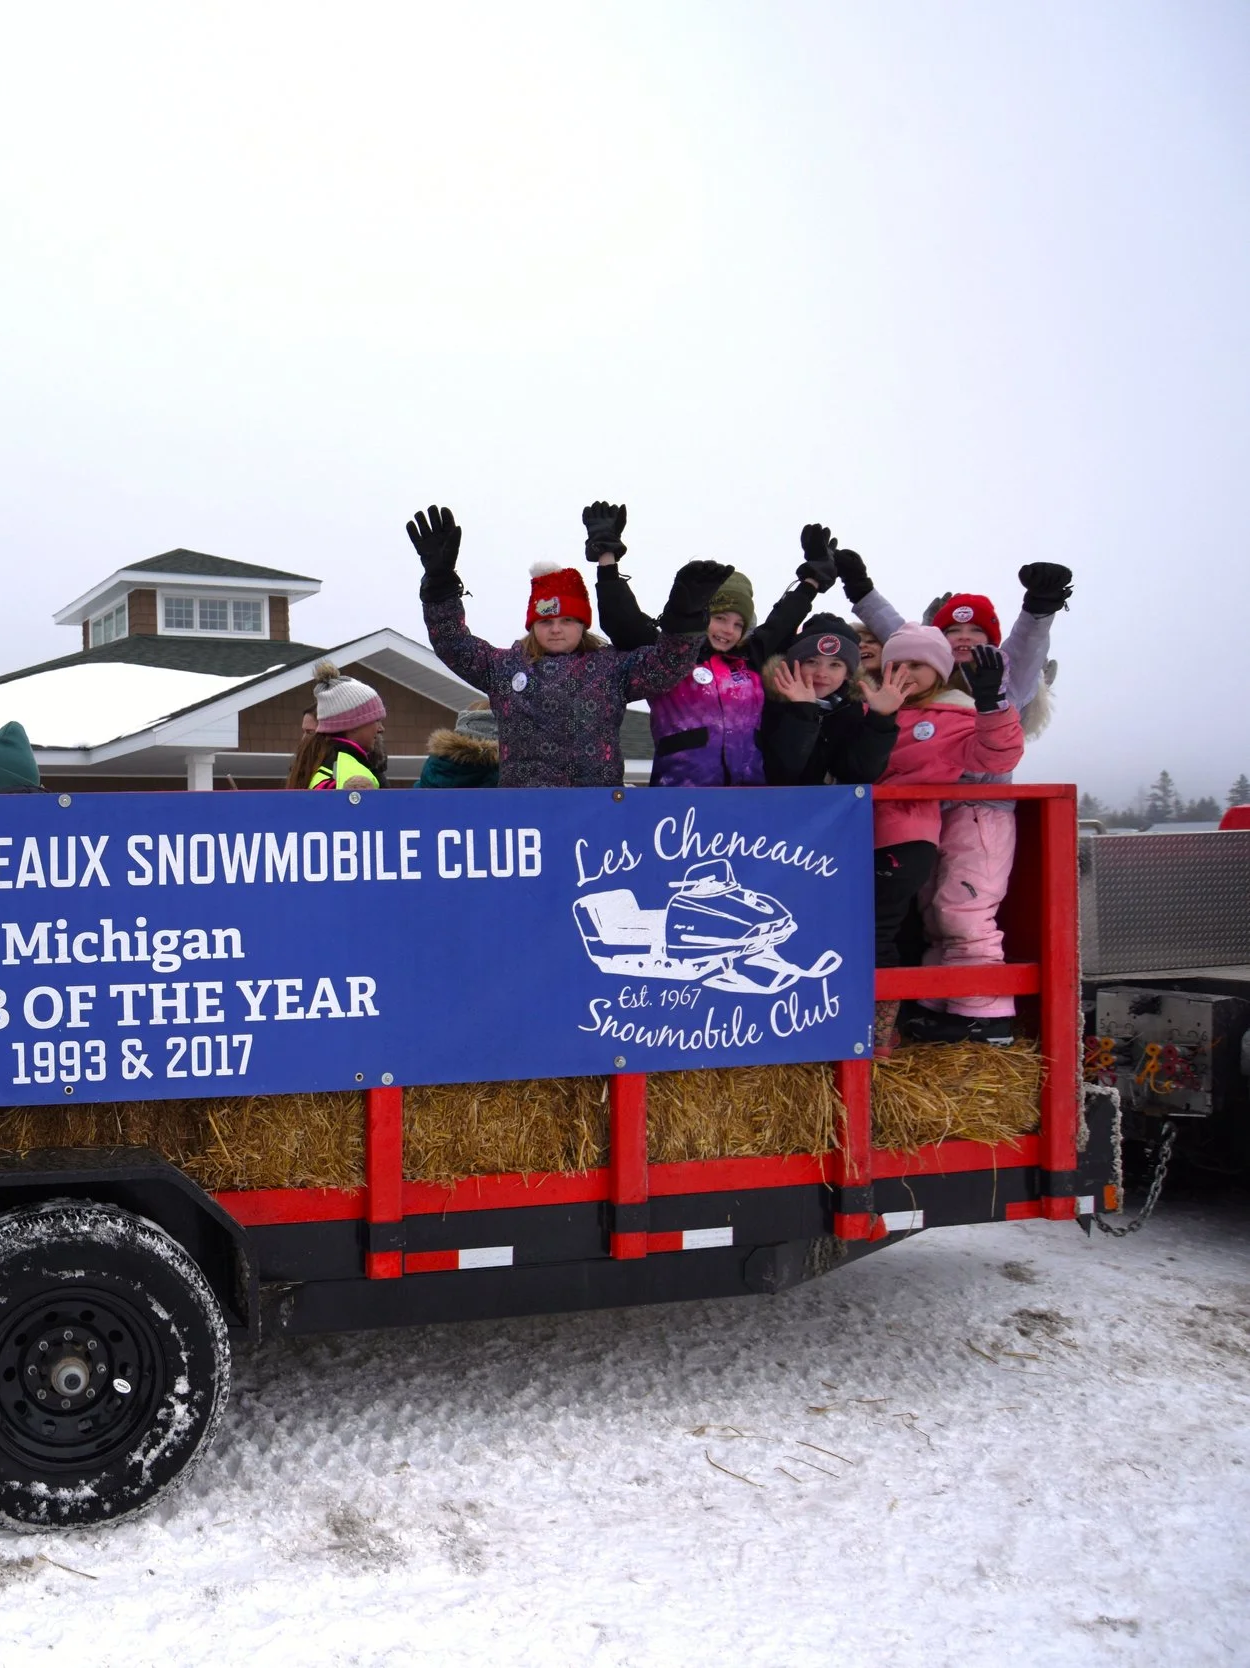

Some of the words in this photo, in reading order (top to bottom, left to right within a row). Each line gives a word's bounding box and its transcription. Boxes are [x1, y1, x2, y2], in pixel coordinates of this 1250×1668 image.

[127, 829, 422, 887] SNOWMOBILE
[437, 828, 543, 879] CLUB
[575, 838, 643, 888] Les
[653, 806, 839, 877] Cheneaux
[1, 916, 245, 974] Michigan
[23, 984, 97, 1031] OF
[109, 980, 225, 1027] THE
[235, 976, 380, 1022] YEAR
[577, 997, 764, 1051] Snowmobile
[769, 976, 840, 1038] Club
[617, 984, 653, 1010] Est.
[659, 987, 702, 1010] 1967
[11, 1039, 107, 1085] 1993
[121, 1037, 154, 1081] &
[166, 1033, 253, 1078] 2017
